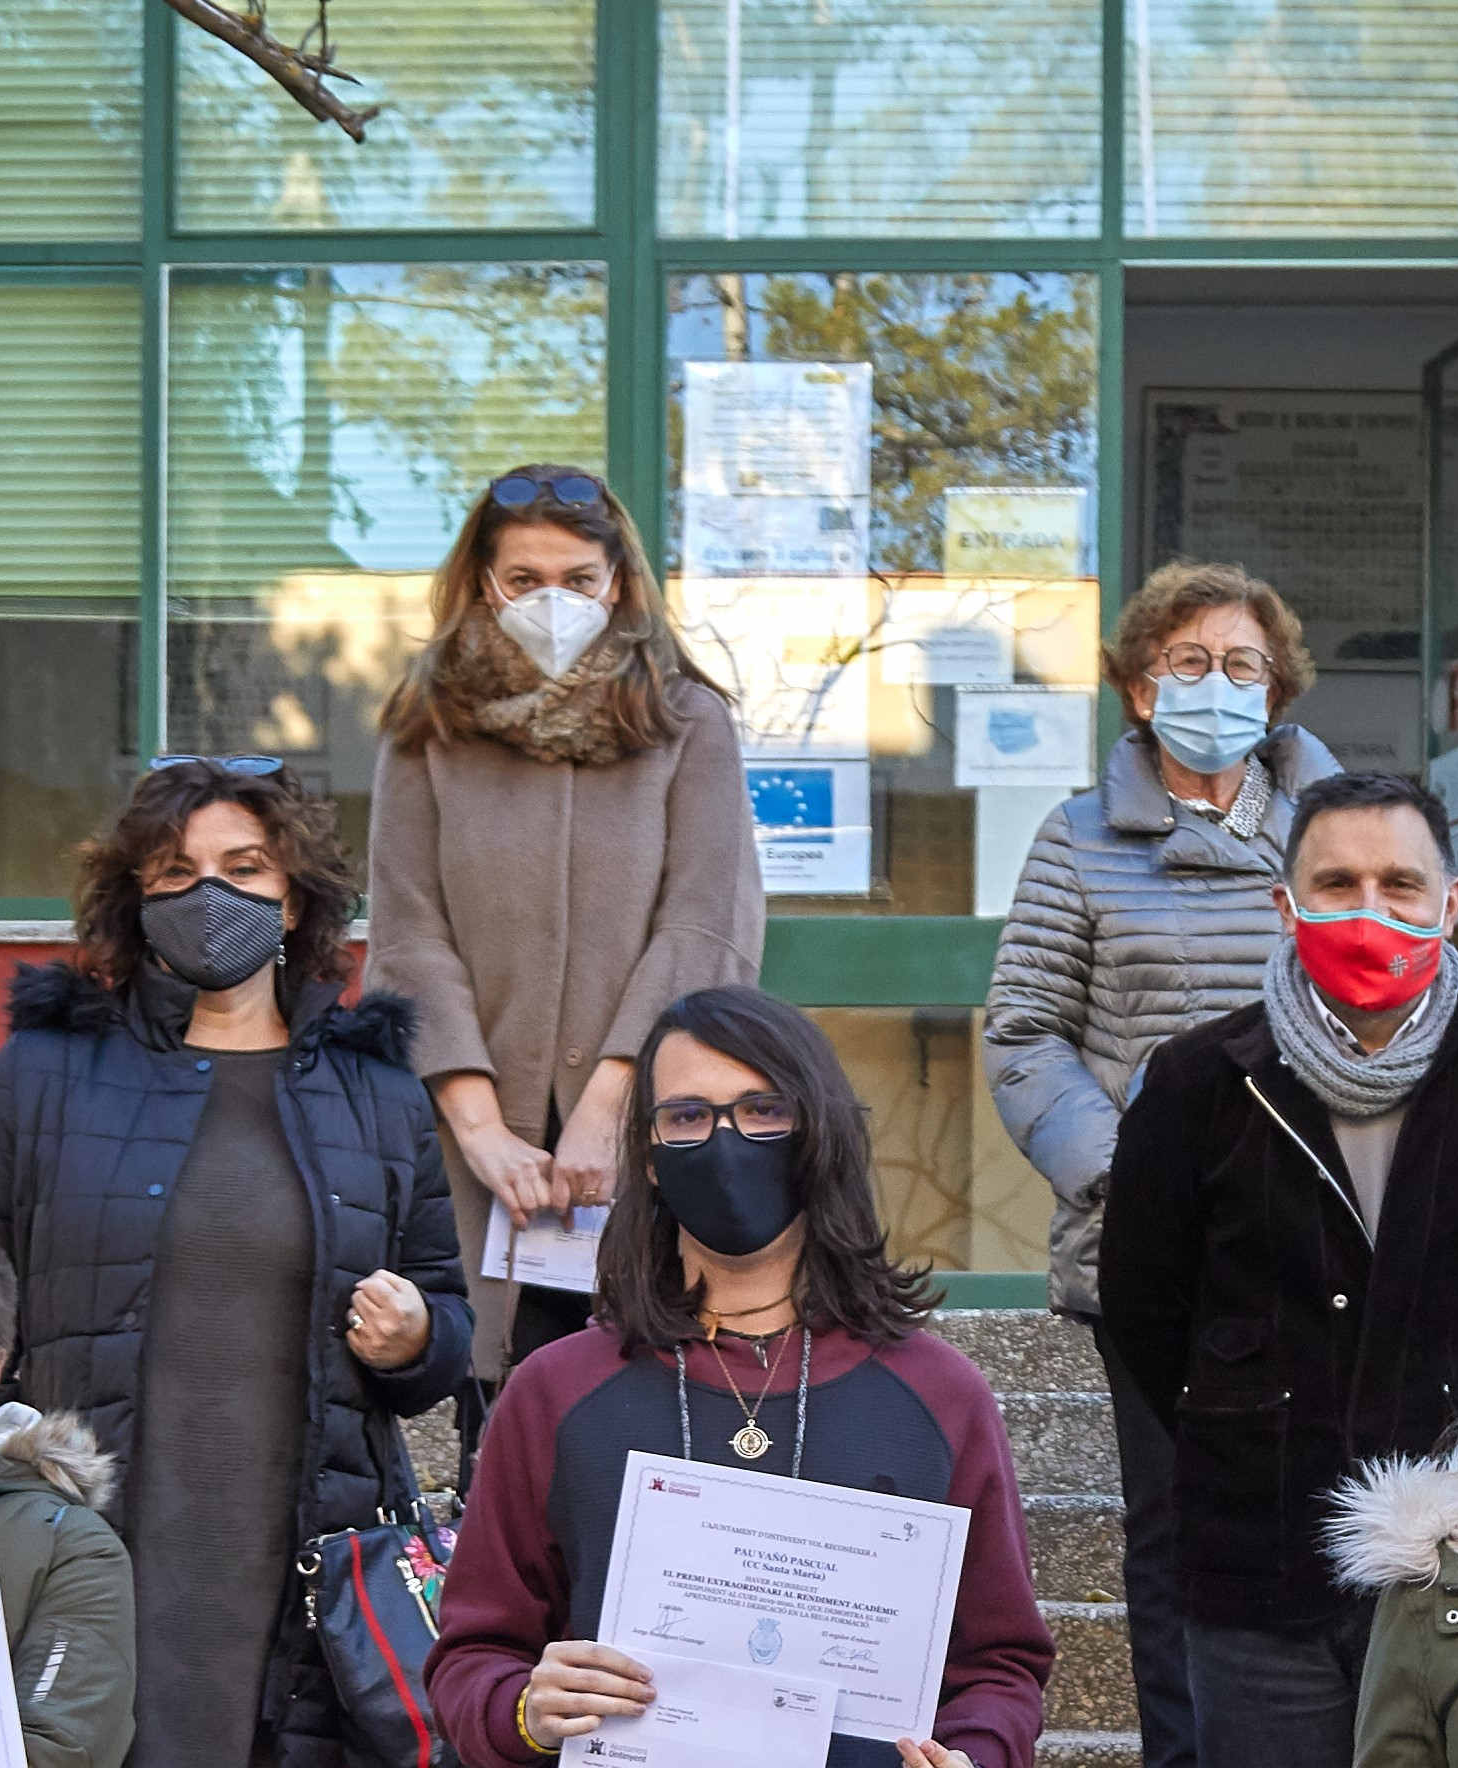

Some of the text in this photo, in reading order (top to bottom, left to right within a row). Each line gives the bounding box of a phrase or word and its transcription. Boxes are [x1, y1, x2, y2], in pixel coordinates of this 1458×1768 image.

[765, 848, 824, 862] Europea
[733, 1546, 755, 1558] PAU
[790, 1555, 838, 1572] PASCUAL
[742, 1559, 760, 1570] (CC
[762, 1562, 790, 1575] Santa
[663, 1569, 674, 1578] EL
[676, 1571, 705, 1583] PREMI
[707, 1576, 781, 1596] EXTRAORDINARI
[784, 1589, 795, 1598] AL
[797, 1591, 850, 1608] RENDIMENT
